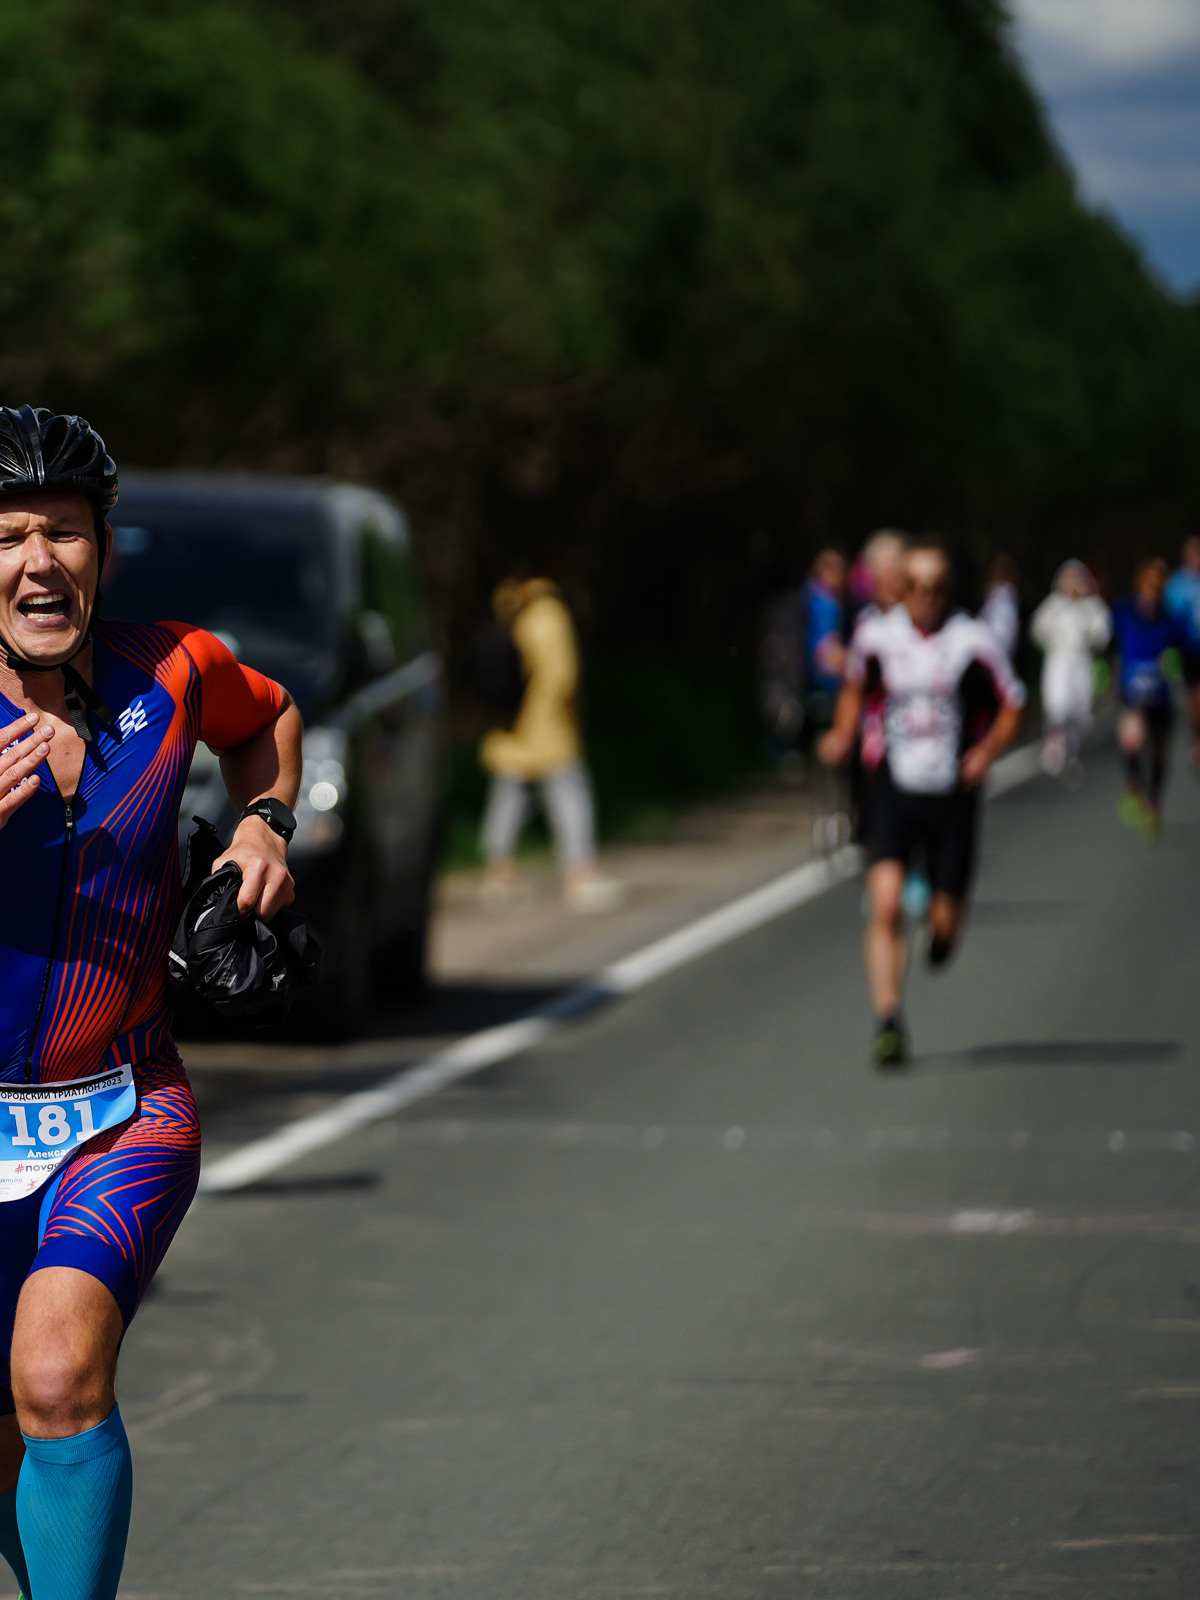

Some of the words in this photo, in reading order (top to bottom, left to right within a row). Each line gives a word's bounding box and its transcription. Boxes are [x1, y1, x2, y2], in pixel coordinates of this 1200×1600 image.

[54, 1084, 100, 1099] ТРИАТЛОН
[102, 1076, 122, 1089] 2023
[9, 1100, 101, 1146] 181
[27, 1148, 69, 1159] Алекса
